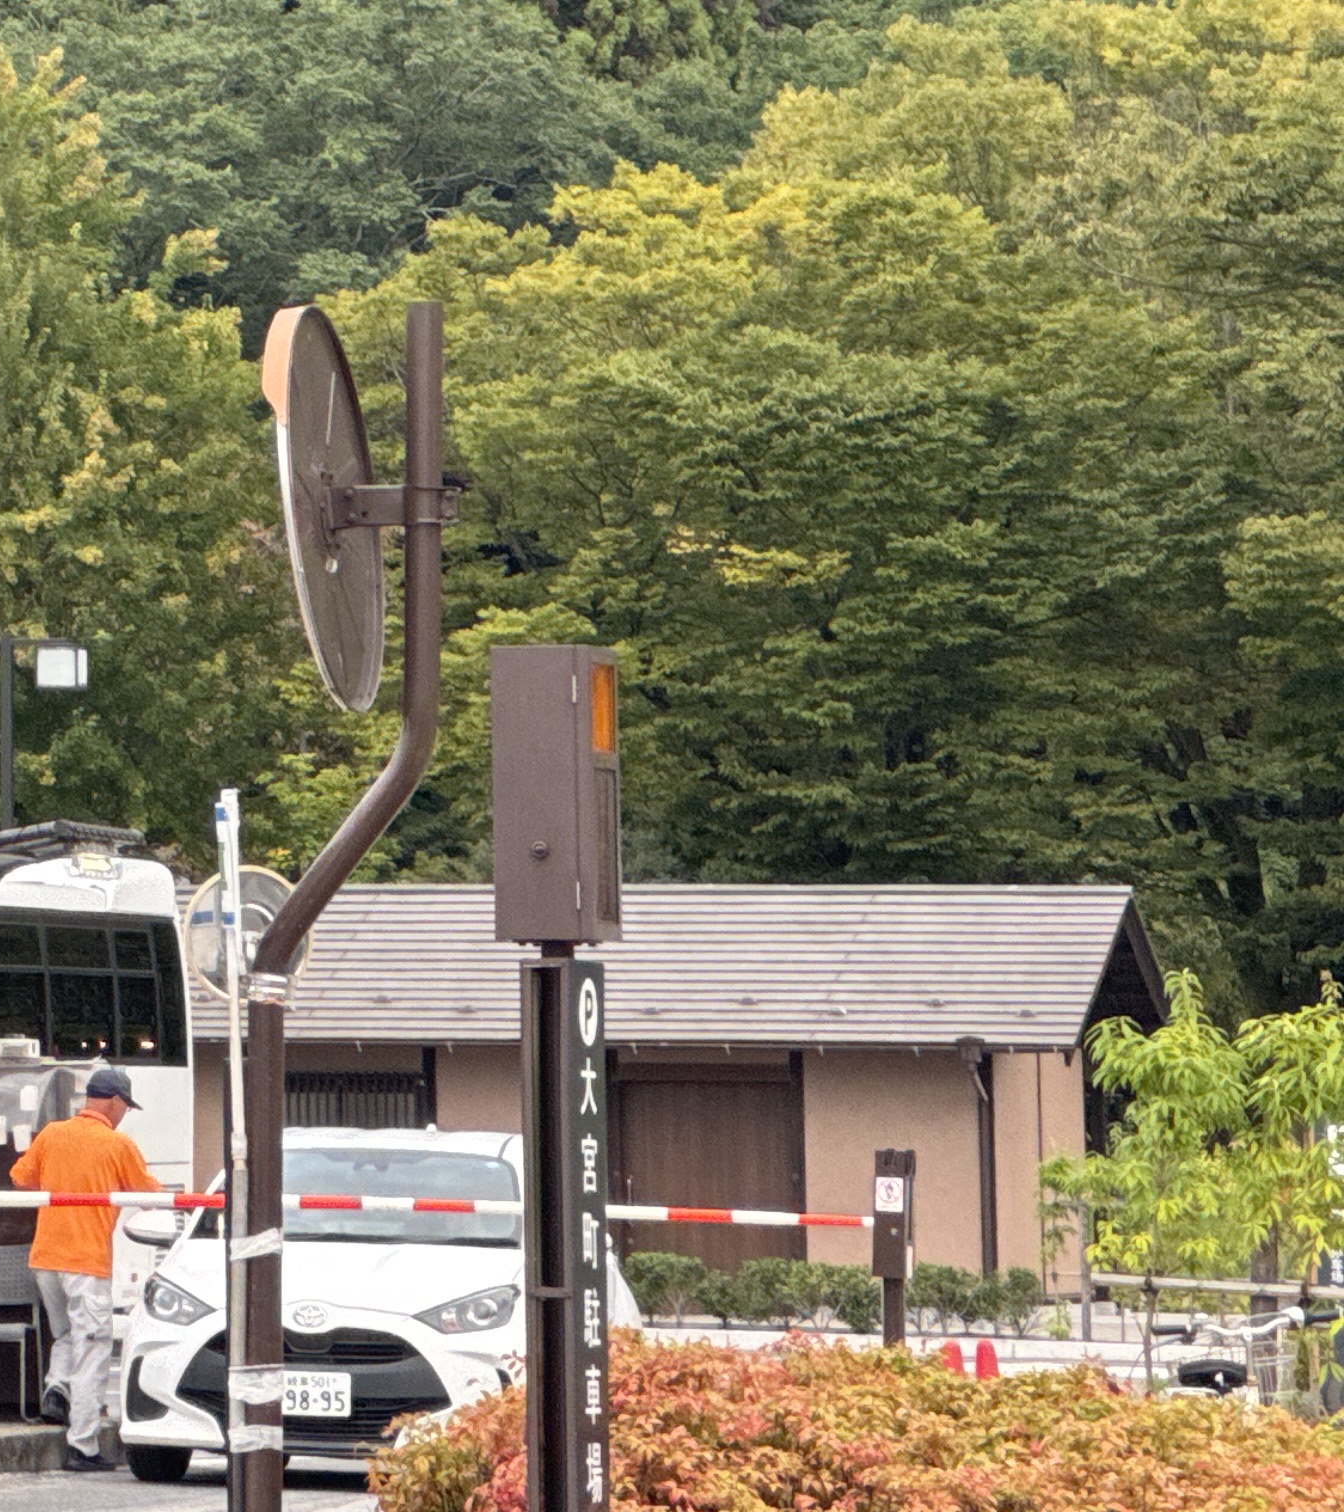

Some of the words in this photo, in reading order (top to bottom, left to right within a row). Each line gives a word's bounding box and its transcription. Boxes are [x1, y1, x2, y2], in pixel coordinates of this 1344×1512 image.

[579, 1057, 603, 1504] 大宮町駐車場
